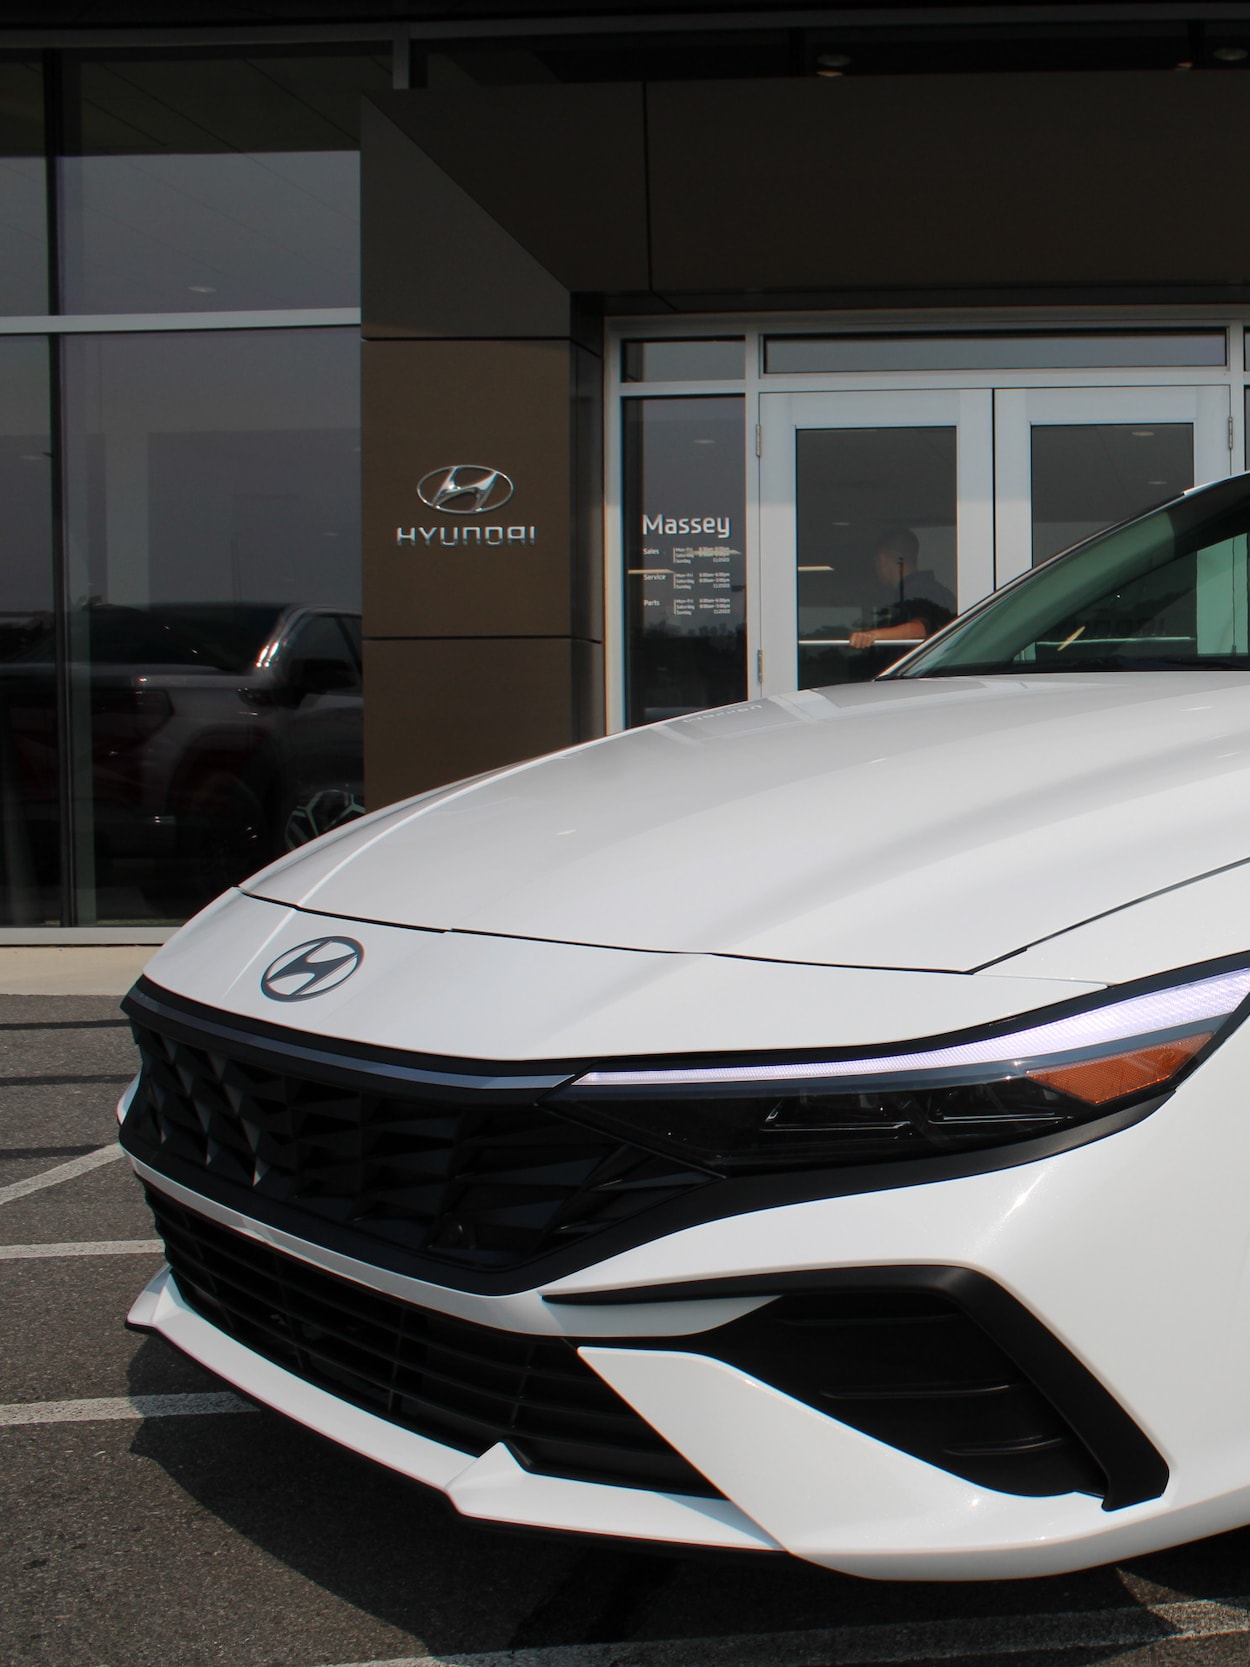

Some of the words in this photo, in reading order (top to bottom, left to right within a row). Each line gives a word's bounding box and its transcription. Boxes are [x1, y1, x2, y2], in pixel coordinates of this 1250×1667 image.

[642, 513, 730, 539] Massey
[396, 526, 536, 546] HYUNDAI
[643, 547, 660, 555] Sales
[643, 573, 667, 581] Service
